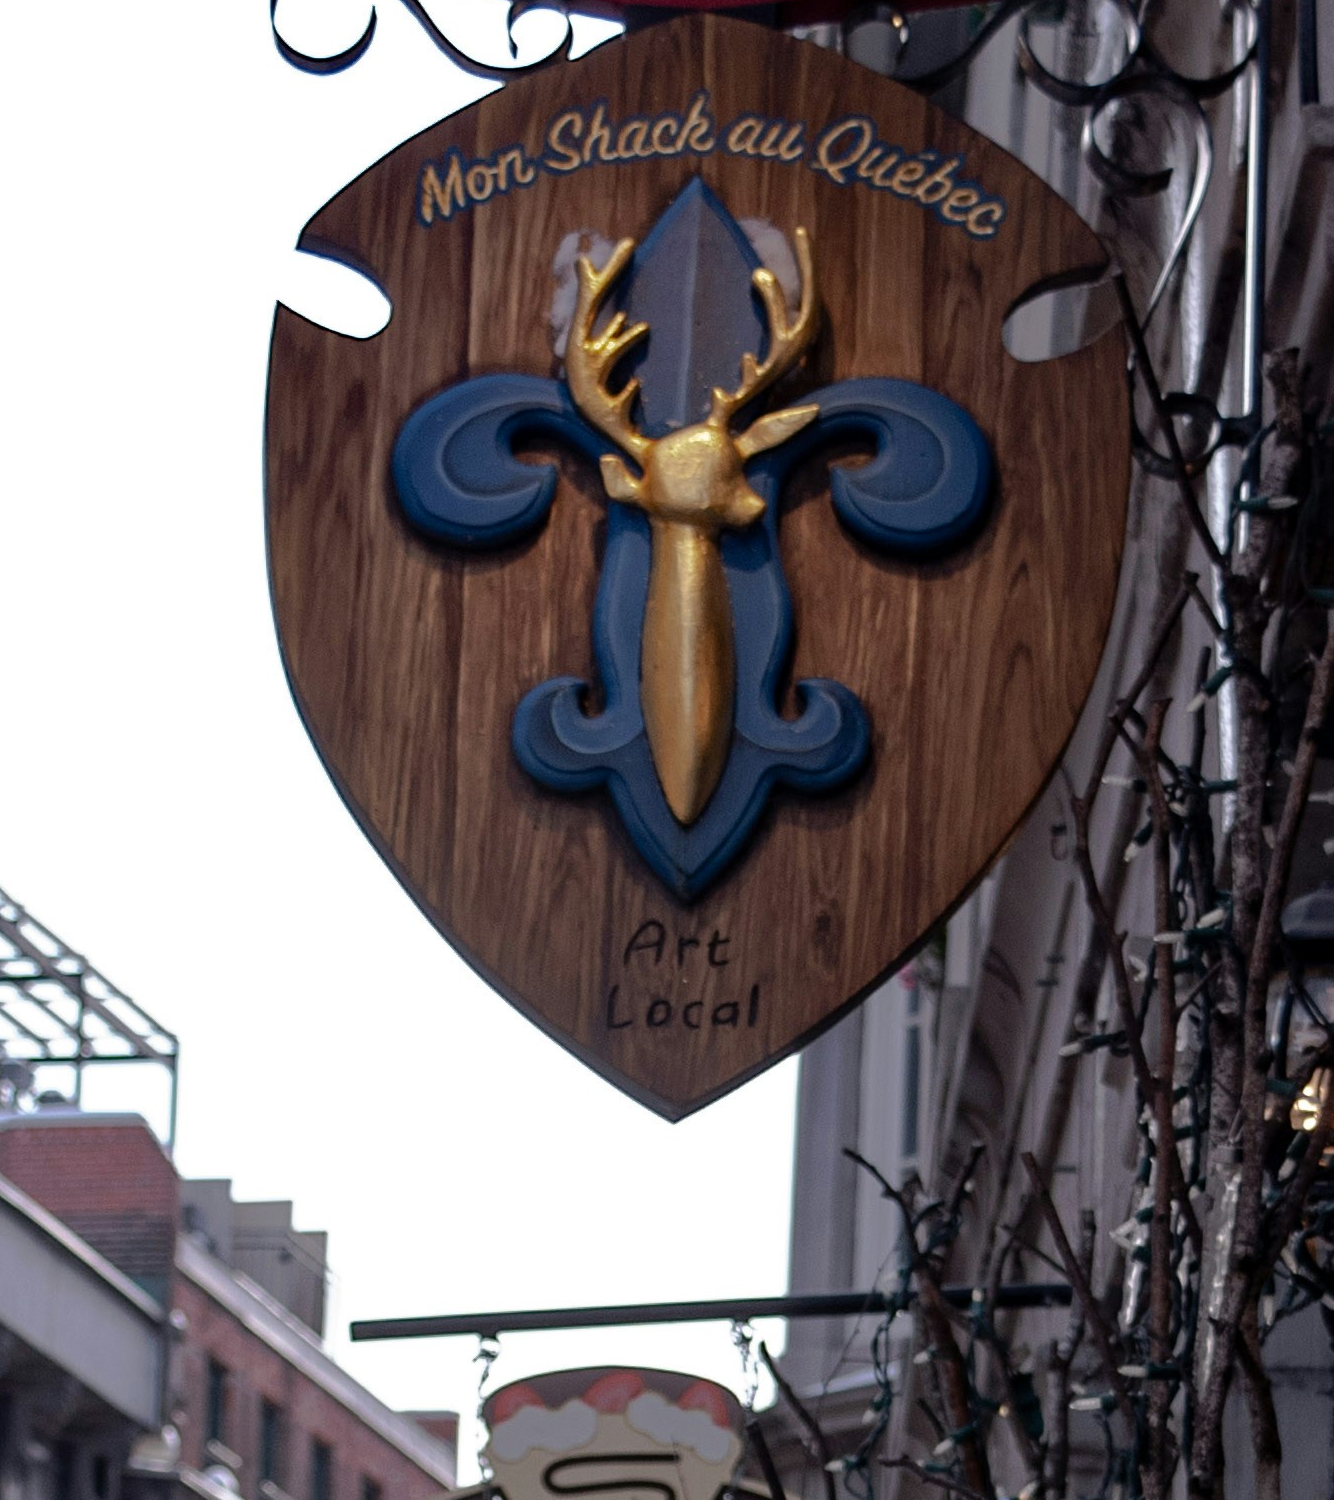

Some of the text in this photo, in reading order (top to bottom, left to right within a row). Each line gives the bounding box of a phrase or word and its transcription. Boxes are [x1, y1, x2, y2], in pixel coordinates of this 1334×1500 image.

[419, 94, 1005, 237] Mon Shack au Québec
[623, 918, 731, 967] Art
[606, 983, 760, 1029] Local
